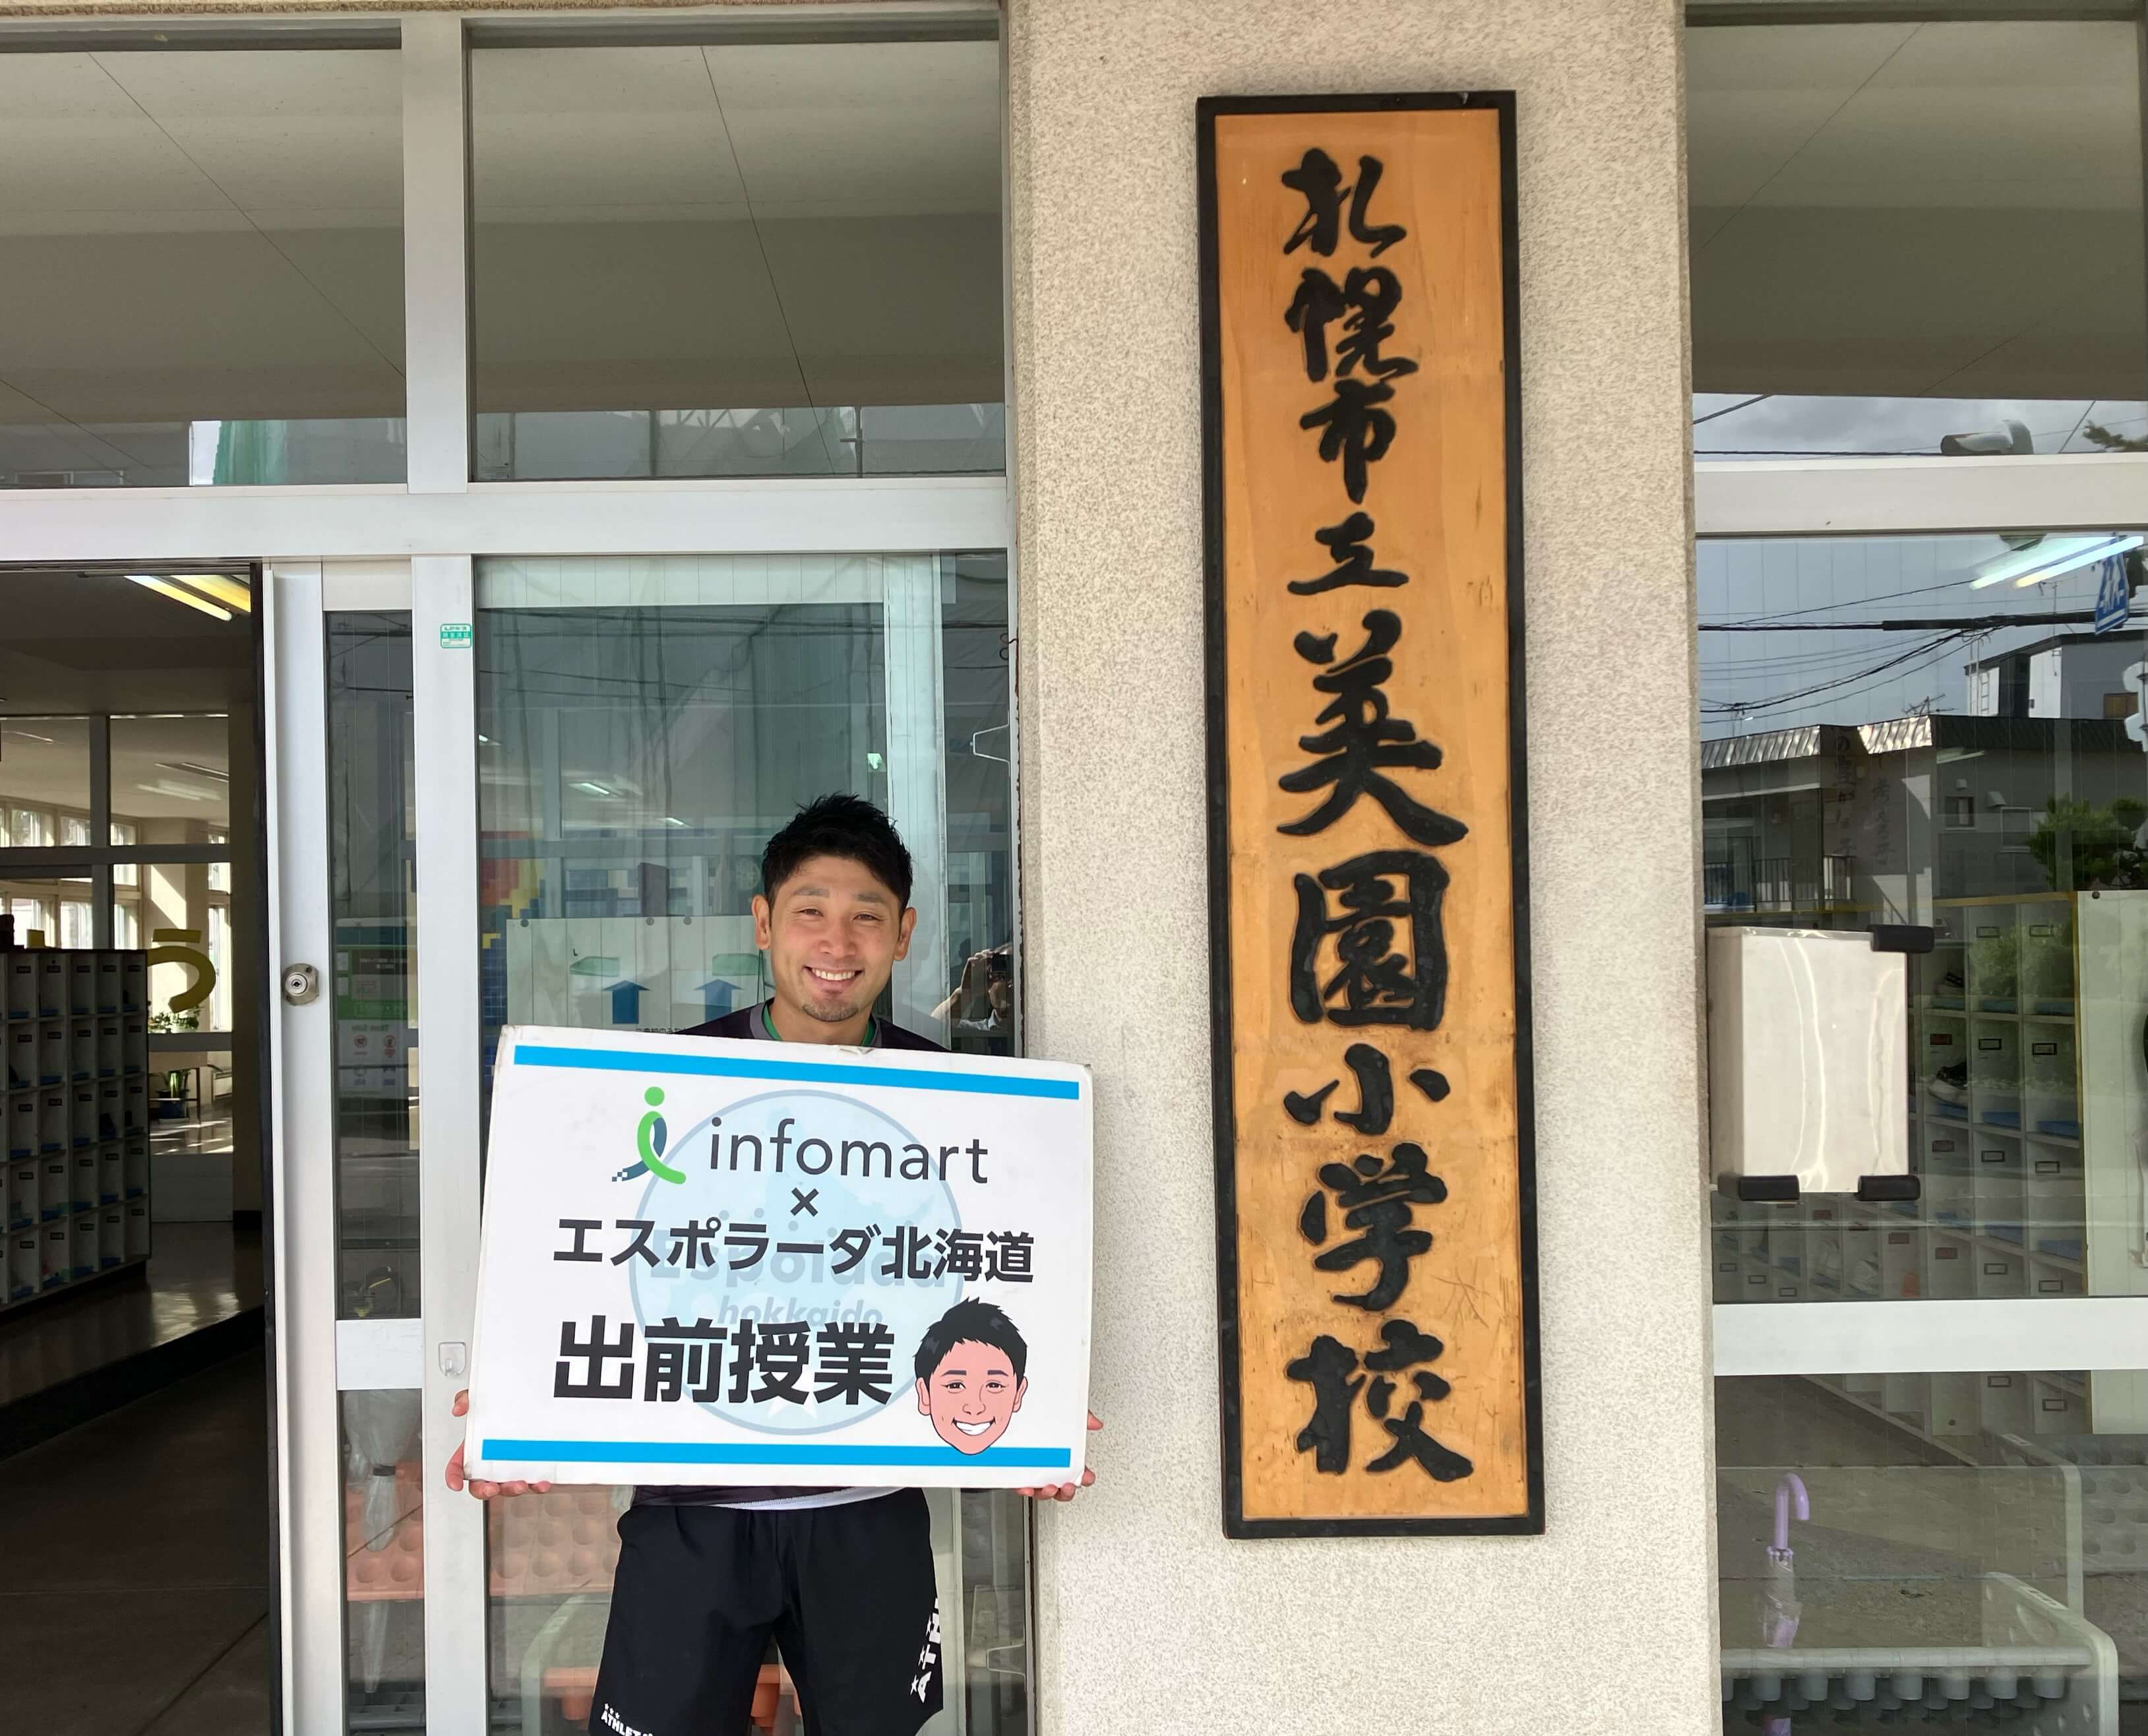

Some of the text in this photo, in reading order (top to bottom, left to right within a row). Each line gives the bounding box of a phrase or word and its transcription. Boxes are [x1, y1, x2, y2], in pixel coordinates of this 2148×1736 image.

[1276, 148, 1473, 1483] 札幌市立美園小学校
[710, 1117, 988, 1185] infomart
[553, 1216, 1035, 1284] エスポラーダ北海道
[718, 1295, 883, 1328] hokkaido
[553, 1315, 895, 1406] 出前授業
